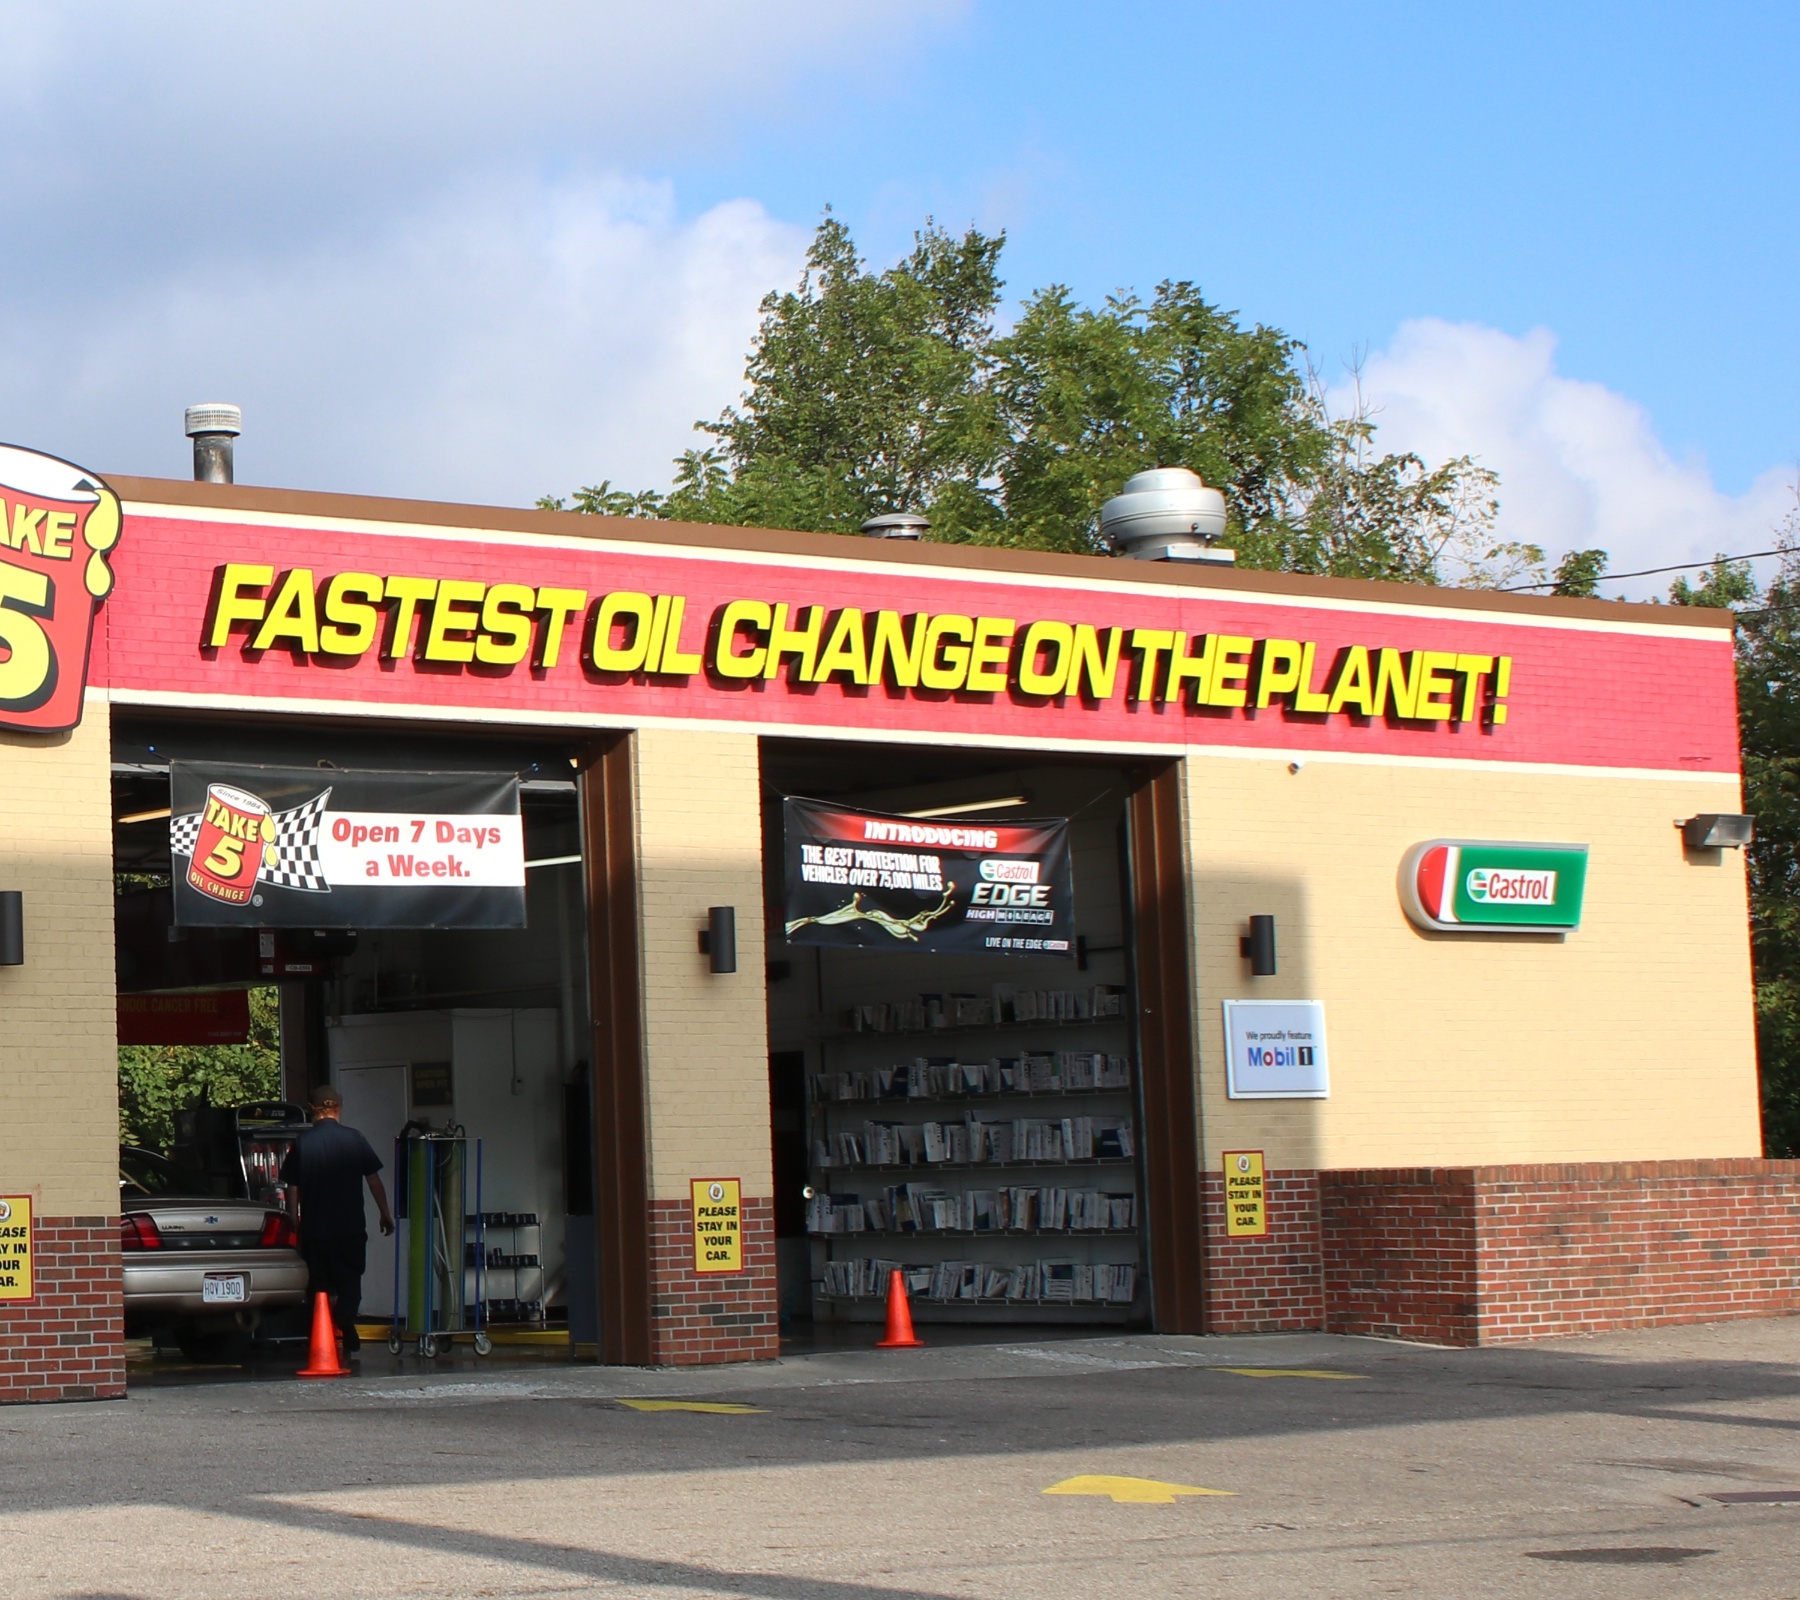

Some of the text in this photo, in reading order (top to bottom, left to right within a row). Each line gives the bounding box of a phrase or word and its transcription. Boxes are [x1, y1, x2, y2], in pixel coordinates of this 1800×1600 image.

[209, 563, 1512, 726] FASTEST OIL CHANGE ON THE PLANET!
[217, 788, 261, 810] Since 1984
[205, 797, 259, 843] TAKE
[332, 818, 501, 849] Open 7 Days
[864, 821, 998, 849] INTRODUCING
[204, 835, 245, 879] 5
[801, 844, 941, 873] THE BEST PROTECTION FOR
[365, 854, 471, 877] a Week.
[996, 863, 1034, 880] Castrol
[801, 864, 943, 891] VEHICLES OVER 75,000 MILES
[191, 872, 245, 900] OIL CHANGE
[1489, 873, 1549, 899] Castrol
[970, 882, 1052, 907] EDGE
[966, 909, 1052, 922] HIGH MILEAGE
[985, 937, 1001, 948] LIVE
[1001, 938, 1011, 948] ON
[1012, 938, 1024, 949] THE
[1025, 939, 1042, 949] EDGE
[194, 998, 218, 1013] FREE
[1246, 1030, 1312, 1041] We proudly feature
[1247, 1046, 1312, 1067] Mobil 1
[1229, 1177, 1261, 1186] PLEASE
[1228, 1190, 1262, 1199] STAY IN
[698, 1206, 737, 1217] PLEASE
[1234, 1204, 1258, 1212] YOUR
[697, 1221, 738, 1231] STAY IN
[1236, 1217, 1257, 1226] CAR.
[13, 1243, 27, 1254] IN
[703, 1236, 732, 1246] YOUR
[706, 1251, 731, 1260] CAR.
[222, 1282, 241, 1295] 1900
